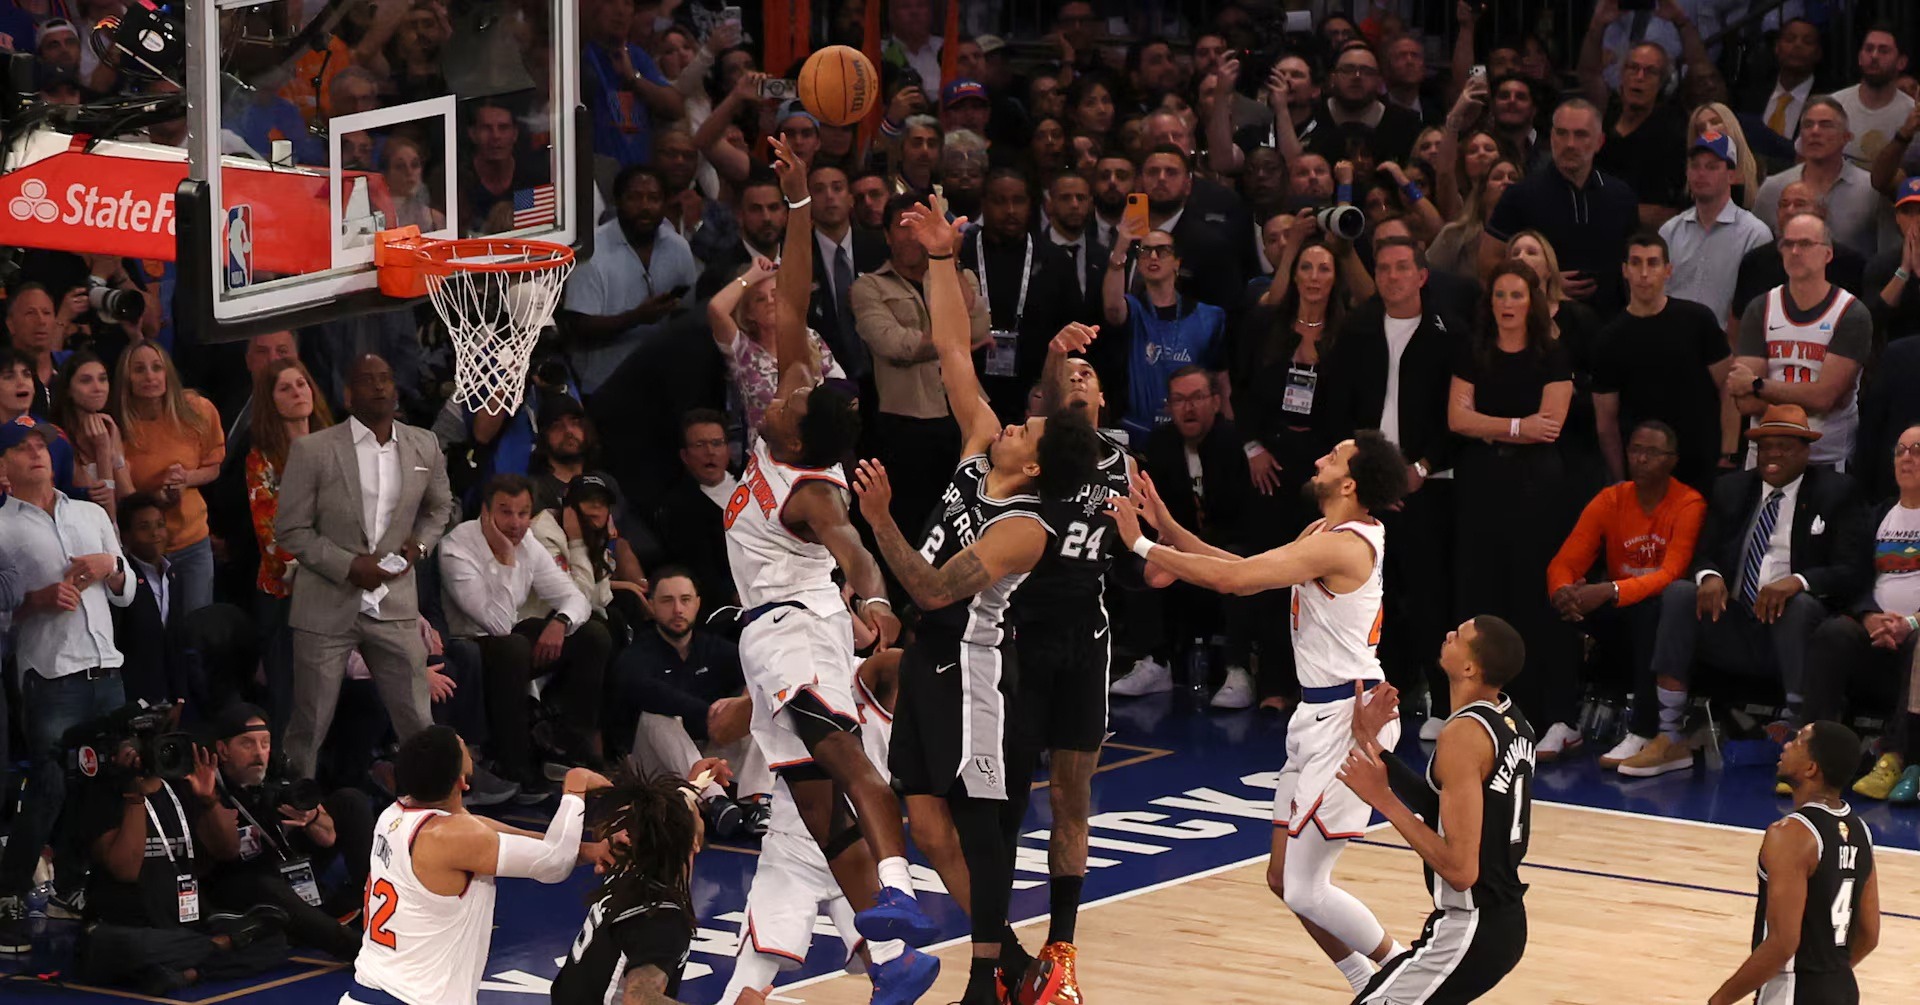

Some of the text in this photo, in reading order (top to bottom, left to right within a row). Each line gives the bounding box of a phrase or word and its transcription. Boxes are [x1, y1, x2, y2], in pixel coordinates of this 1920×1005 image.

[62, 183, 152, 232] State
[723, 483, 751, 532] 8
[919, 523, 946, 565] 2
[1059, 520, 1107, 562] 24
[1509, 773, 1525, 845] 1
[1838, 844, 1859, 870] FOX
[1830, 877, 1856, 947] 4
